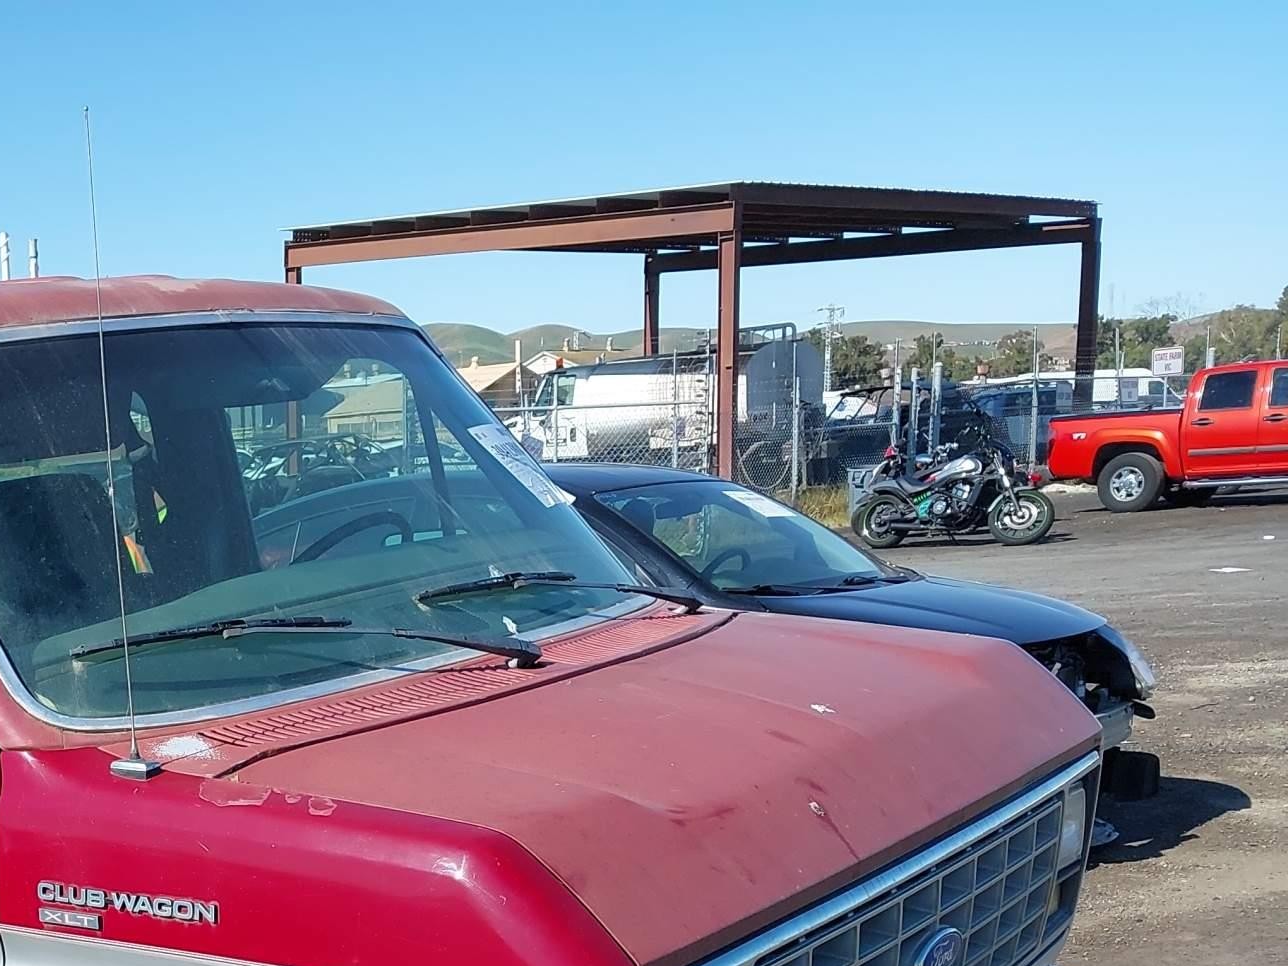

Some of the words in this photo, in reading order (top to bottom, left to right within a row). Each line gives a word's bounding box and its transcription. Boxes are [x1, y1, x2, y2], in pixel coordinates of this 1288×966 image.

[37, 882, 105, 909] CLUB
[111, 892, 215, 923] WAGON
[43, 910, 95, 928] XLT
